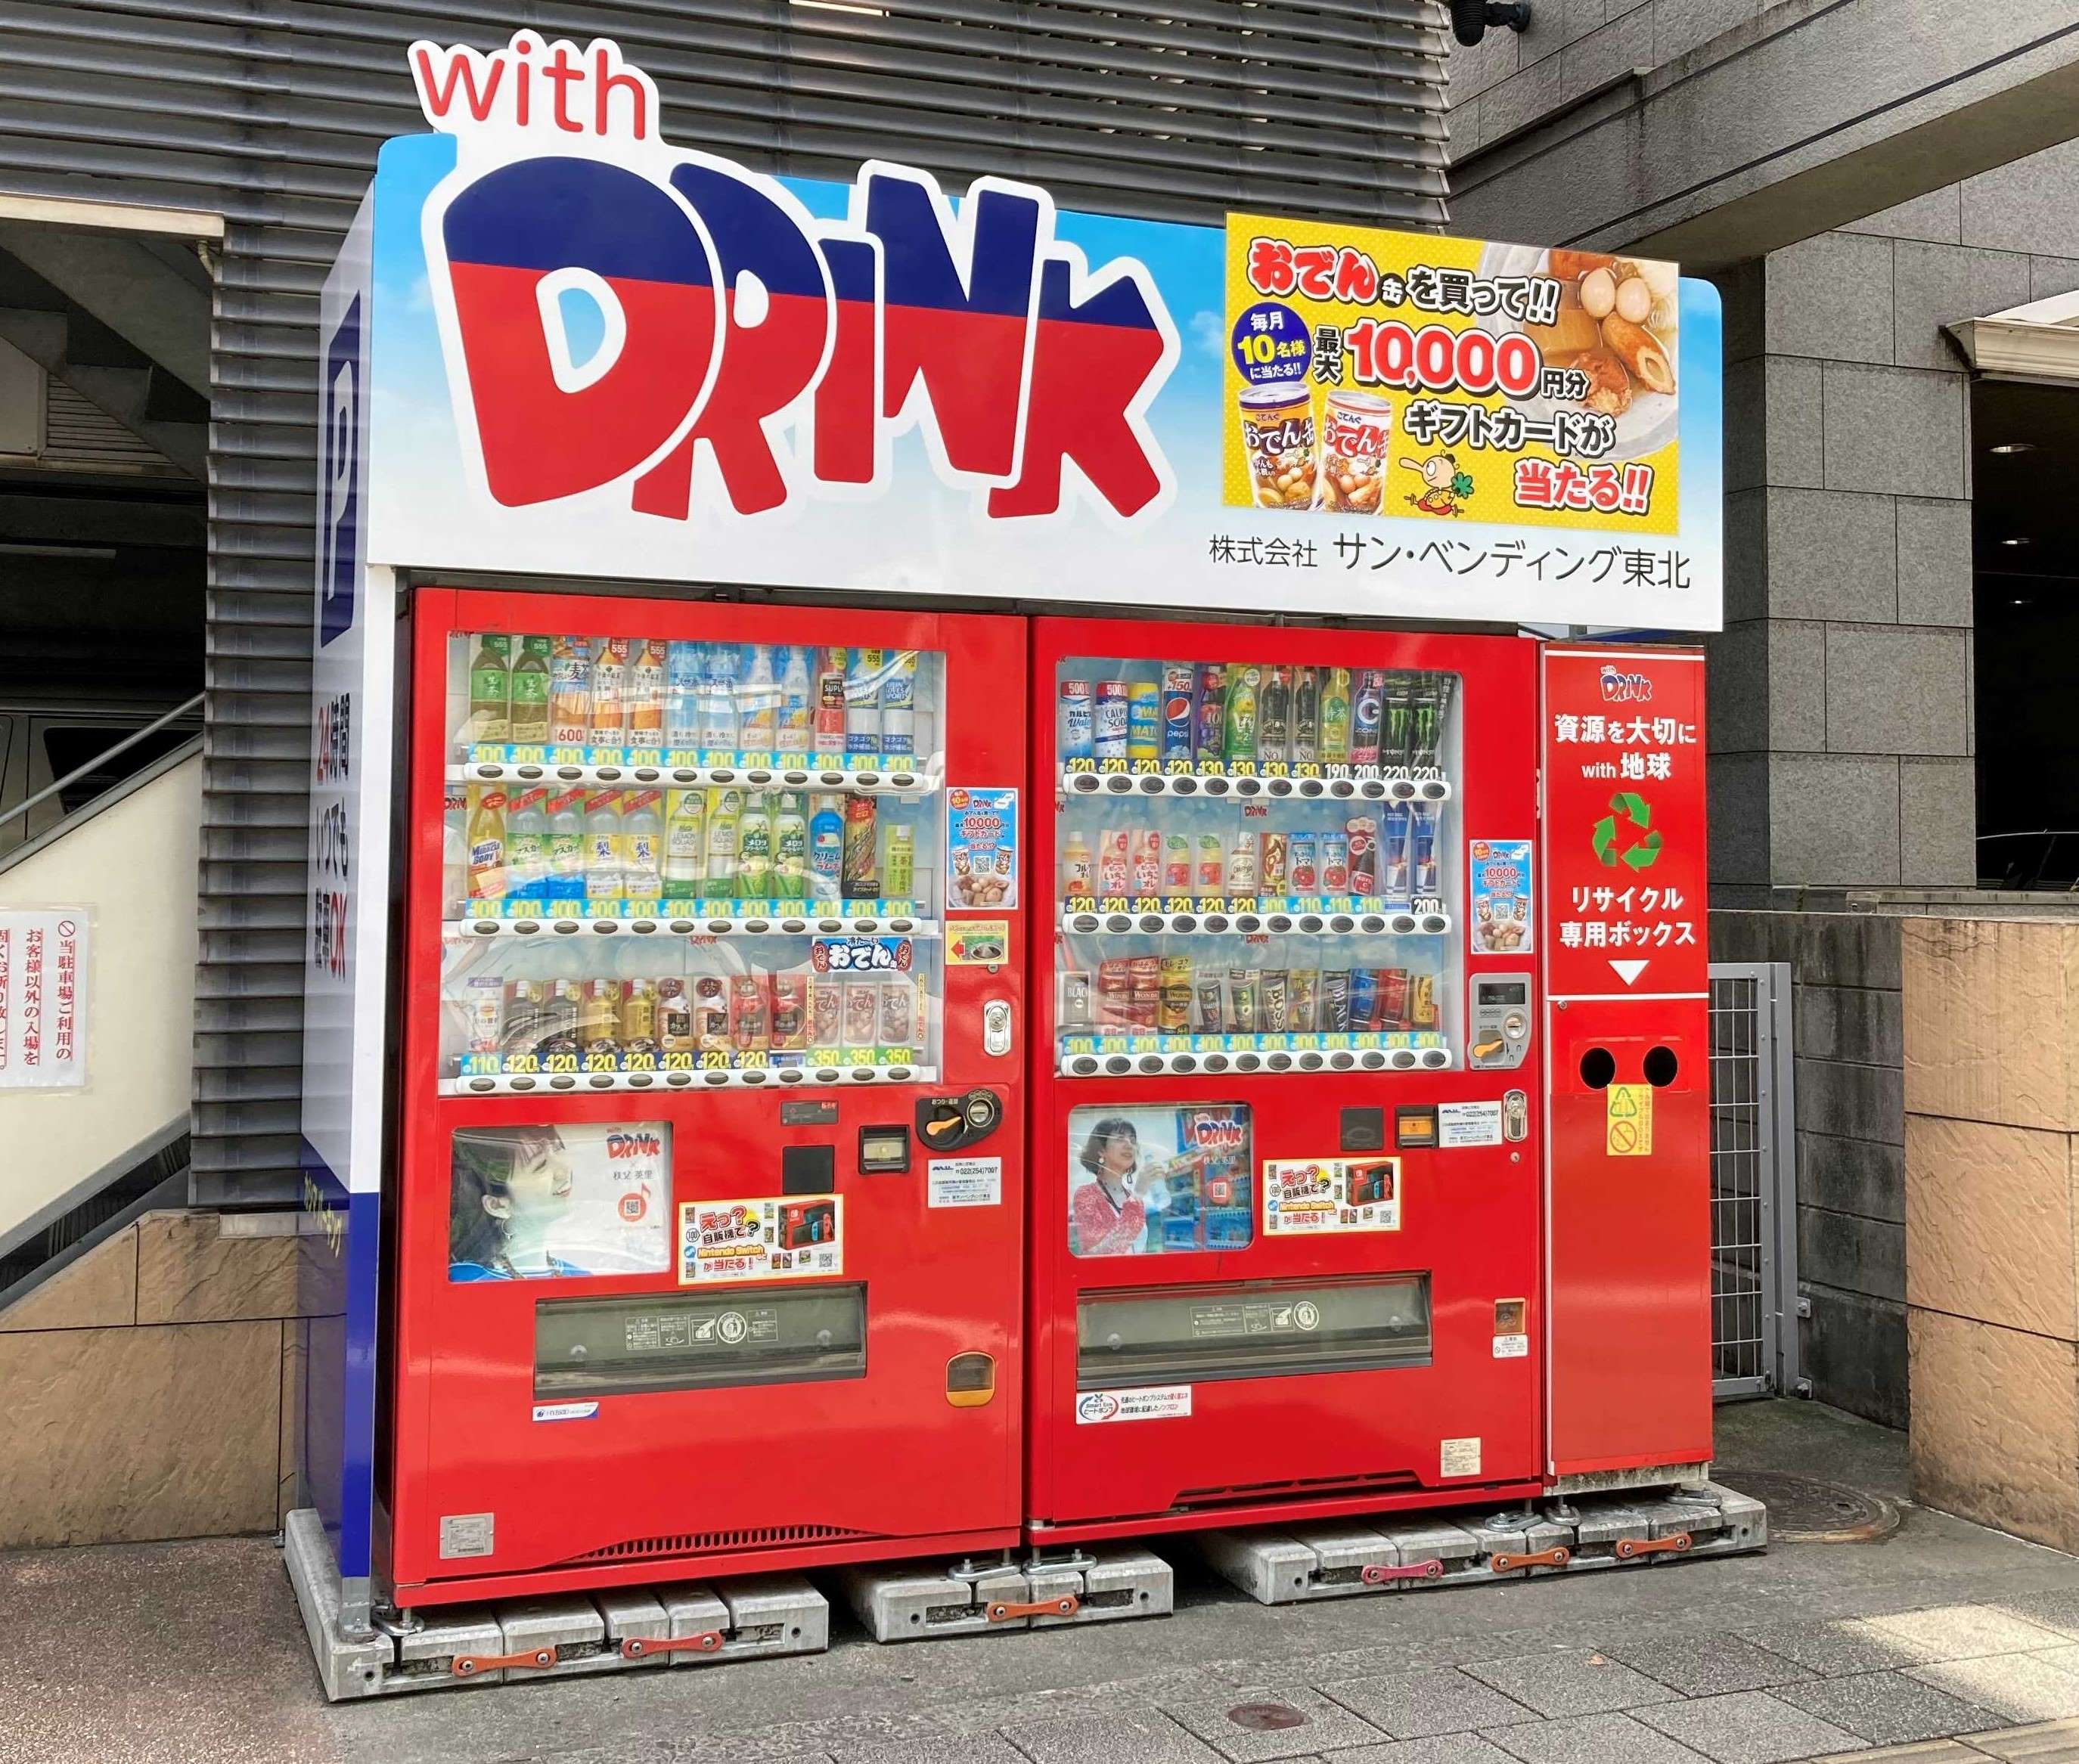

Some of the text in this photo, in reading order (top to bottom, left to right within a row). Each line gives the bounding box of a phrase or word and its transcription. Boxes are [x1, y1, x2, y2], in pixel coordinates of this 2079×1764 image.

[415, 40, 646, 141] with
[1251, 312, 1283, 330] 毎月
[442, 157, 1165, 522] DRINK
[1238, 338, 1306, 365] 10名様
[1315, 327, 1342, 383] 最大
[1404, 403, 1615, 456] ギフトカードが
[327, 360, 352, 600] P
[1515, 460, 1652, 513] 当たる!!
[1209, 532, 1691, 591] 株式会社 サン・ベンディング東北
[612, 644, 627, 653] 555
[650, 646, 666, 654] 555
[1600, 674, 1652, 702] DRINK
[318, 693, 349, 780] 24時間
[559, 728, 582, 742] 600
[1554, 715, 1697, 745] 資源を大切に
[1069, 758, 1094, 772] 120
[1102, 758, 1128, 773] 120
[1135, 759, 1159, 773] 120
[1168, 760, 1193, 774] 120
[1199, 761, 1224, 775] 130
[1231, 761, 1255, 775] 130
[1324, 763, 1348, 779] 190
[1354, 764, 1379, 779] 200
[1383, 766, 1408, 780] 220
[1413, 767, 1438, 780] 220
[1581, 752, 1671, 781] with 地球
[316, 797, 348, 877] いつでも
[1070, 897, 1096, 913] 120
[1102, 898, 1128, 913] 120
[1135, 898, 1161, 913] 120
[1167, 898, 1193, 913] 120
[1199, 898, 1225, 913] 120
[1231, 898, 1256, 913] 120
[1413, 898, 1438, 914] 200
[1572, 886, 1683, 913] リサイクル
[1559, 921, 1696, 950] 専用ボックス
[23, 929, 41, 1065] お客様以外の入場を
[56, 941, 73, 1060] 当駐車場ご利用の
[506, 1054, 538, 1072] 120
[546, 1054, 579, 1072] 120
[586, 1053, 617, 1072] 120
[624, 1053, 655, 1071] 120
[662, 1052, 694, 1071] 120
[700, 1051, 730, 1069] 120
[737, 1051, 767, 1068] 120
[814, 1049, 839, 1066] 350
[849, 1049, 876, 1065] 350
[885, 1048, 911, 1065] 350
[1196, 1122, 1243, 1145] DRINK
[607, 1133, 660, 1159] DRINK
